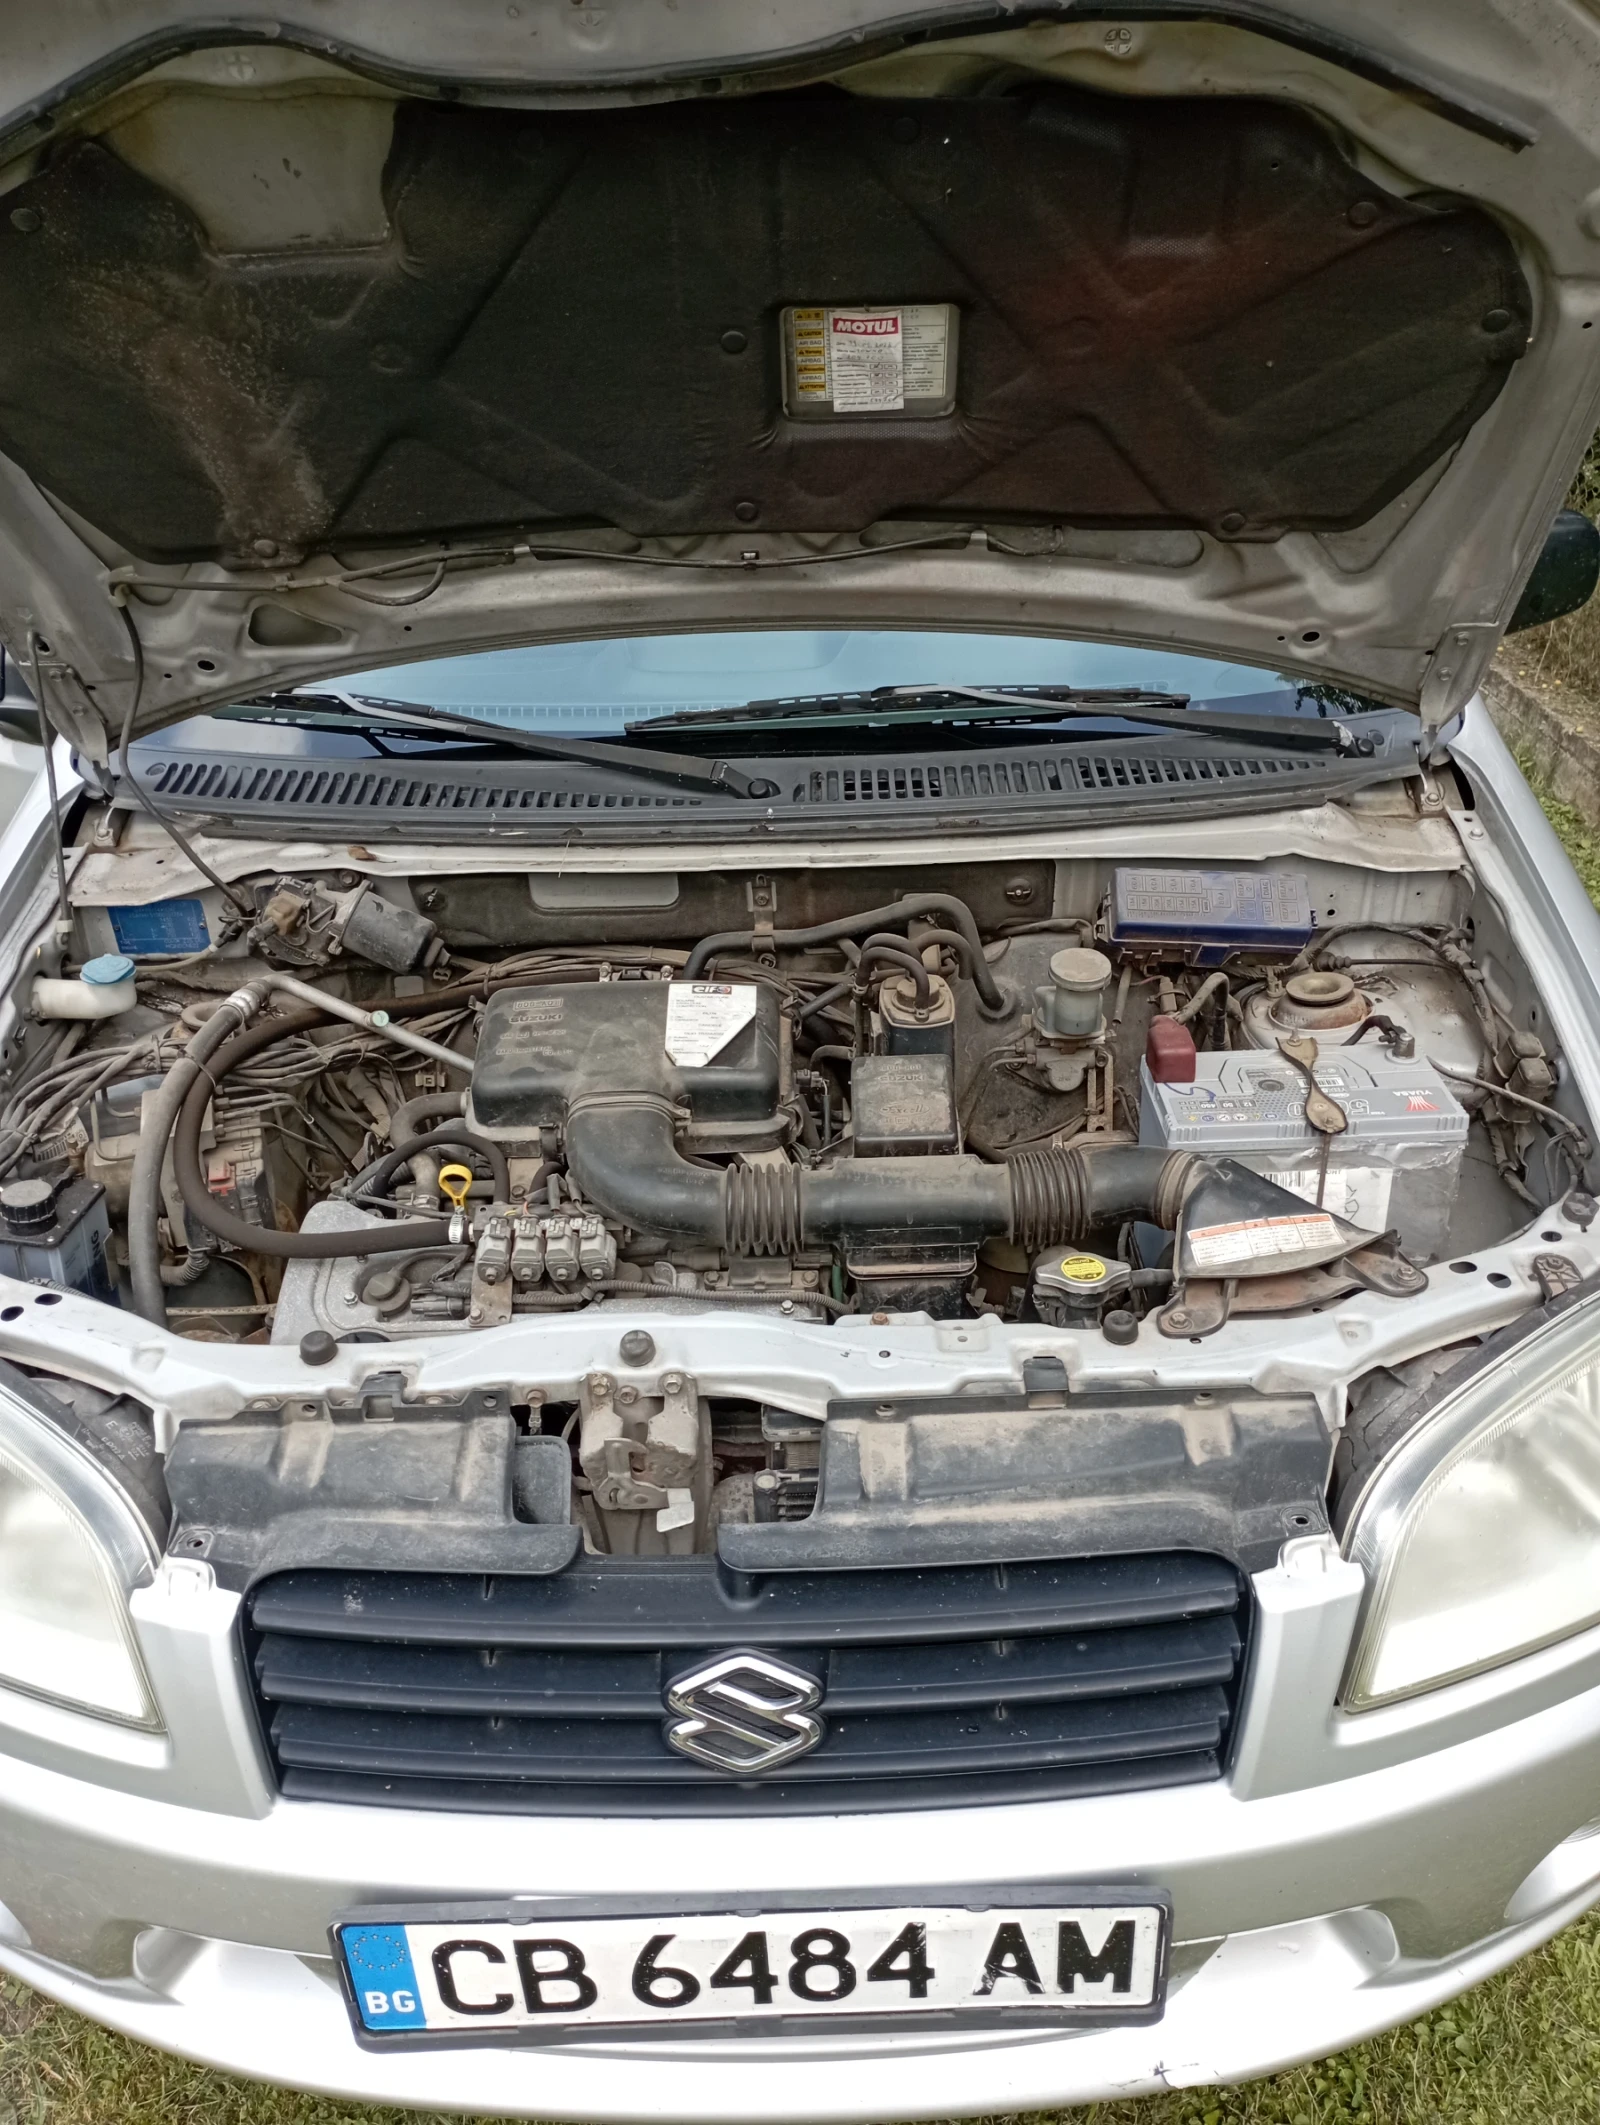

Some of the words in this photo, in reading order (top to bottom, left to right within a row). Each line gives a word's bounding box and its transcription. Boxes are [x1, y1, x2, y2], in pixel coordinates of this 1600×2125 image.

[836, 319, 896, 334] MOTUL
[509, 1014, 562, 1024] SUZUKI
[880, 1074, 926, 1082] SUZUKI
[1392, 1089, 1434, 1097] YUASA
[430, 1938, 600, 2017] CB
[631, 1921, 937, 2009] 6484
[972, 1919, 1138, 1997] AM
[365, 1991, 417, 2015] BG
